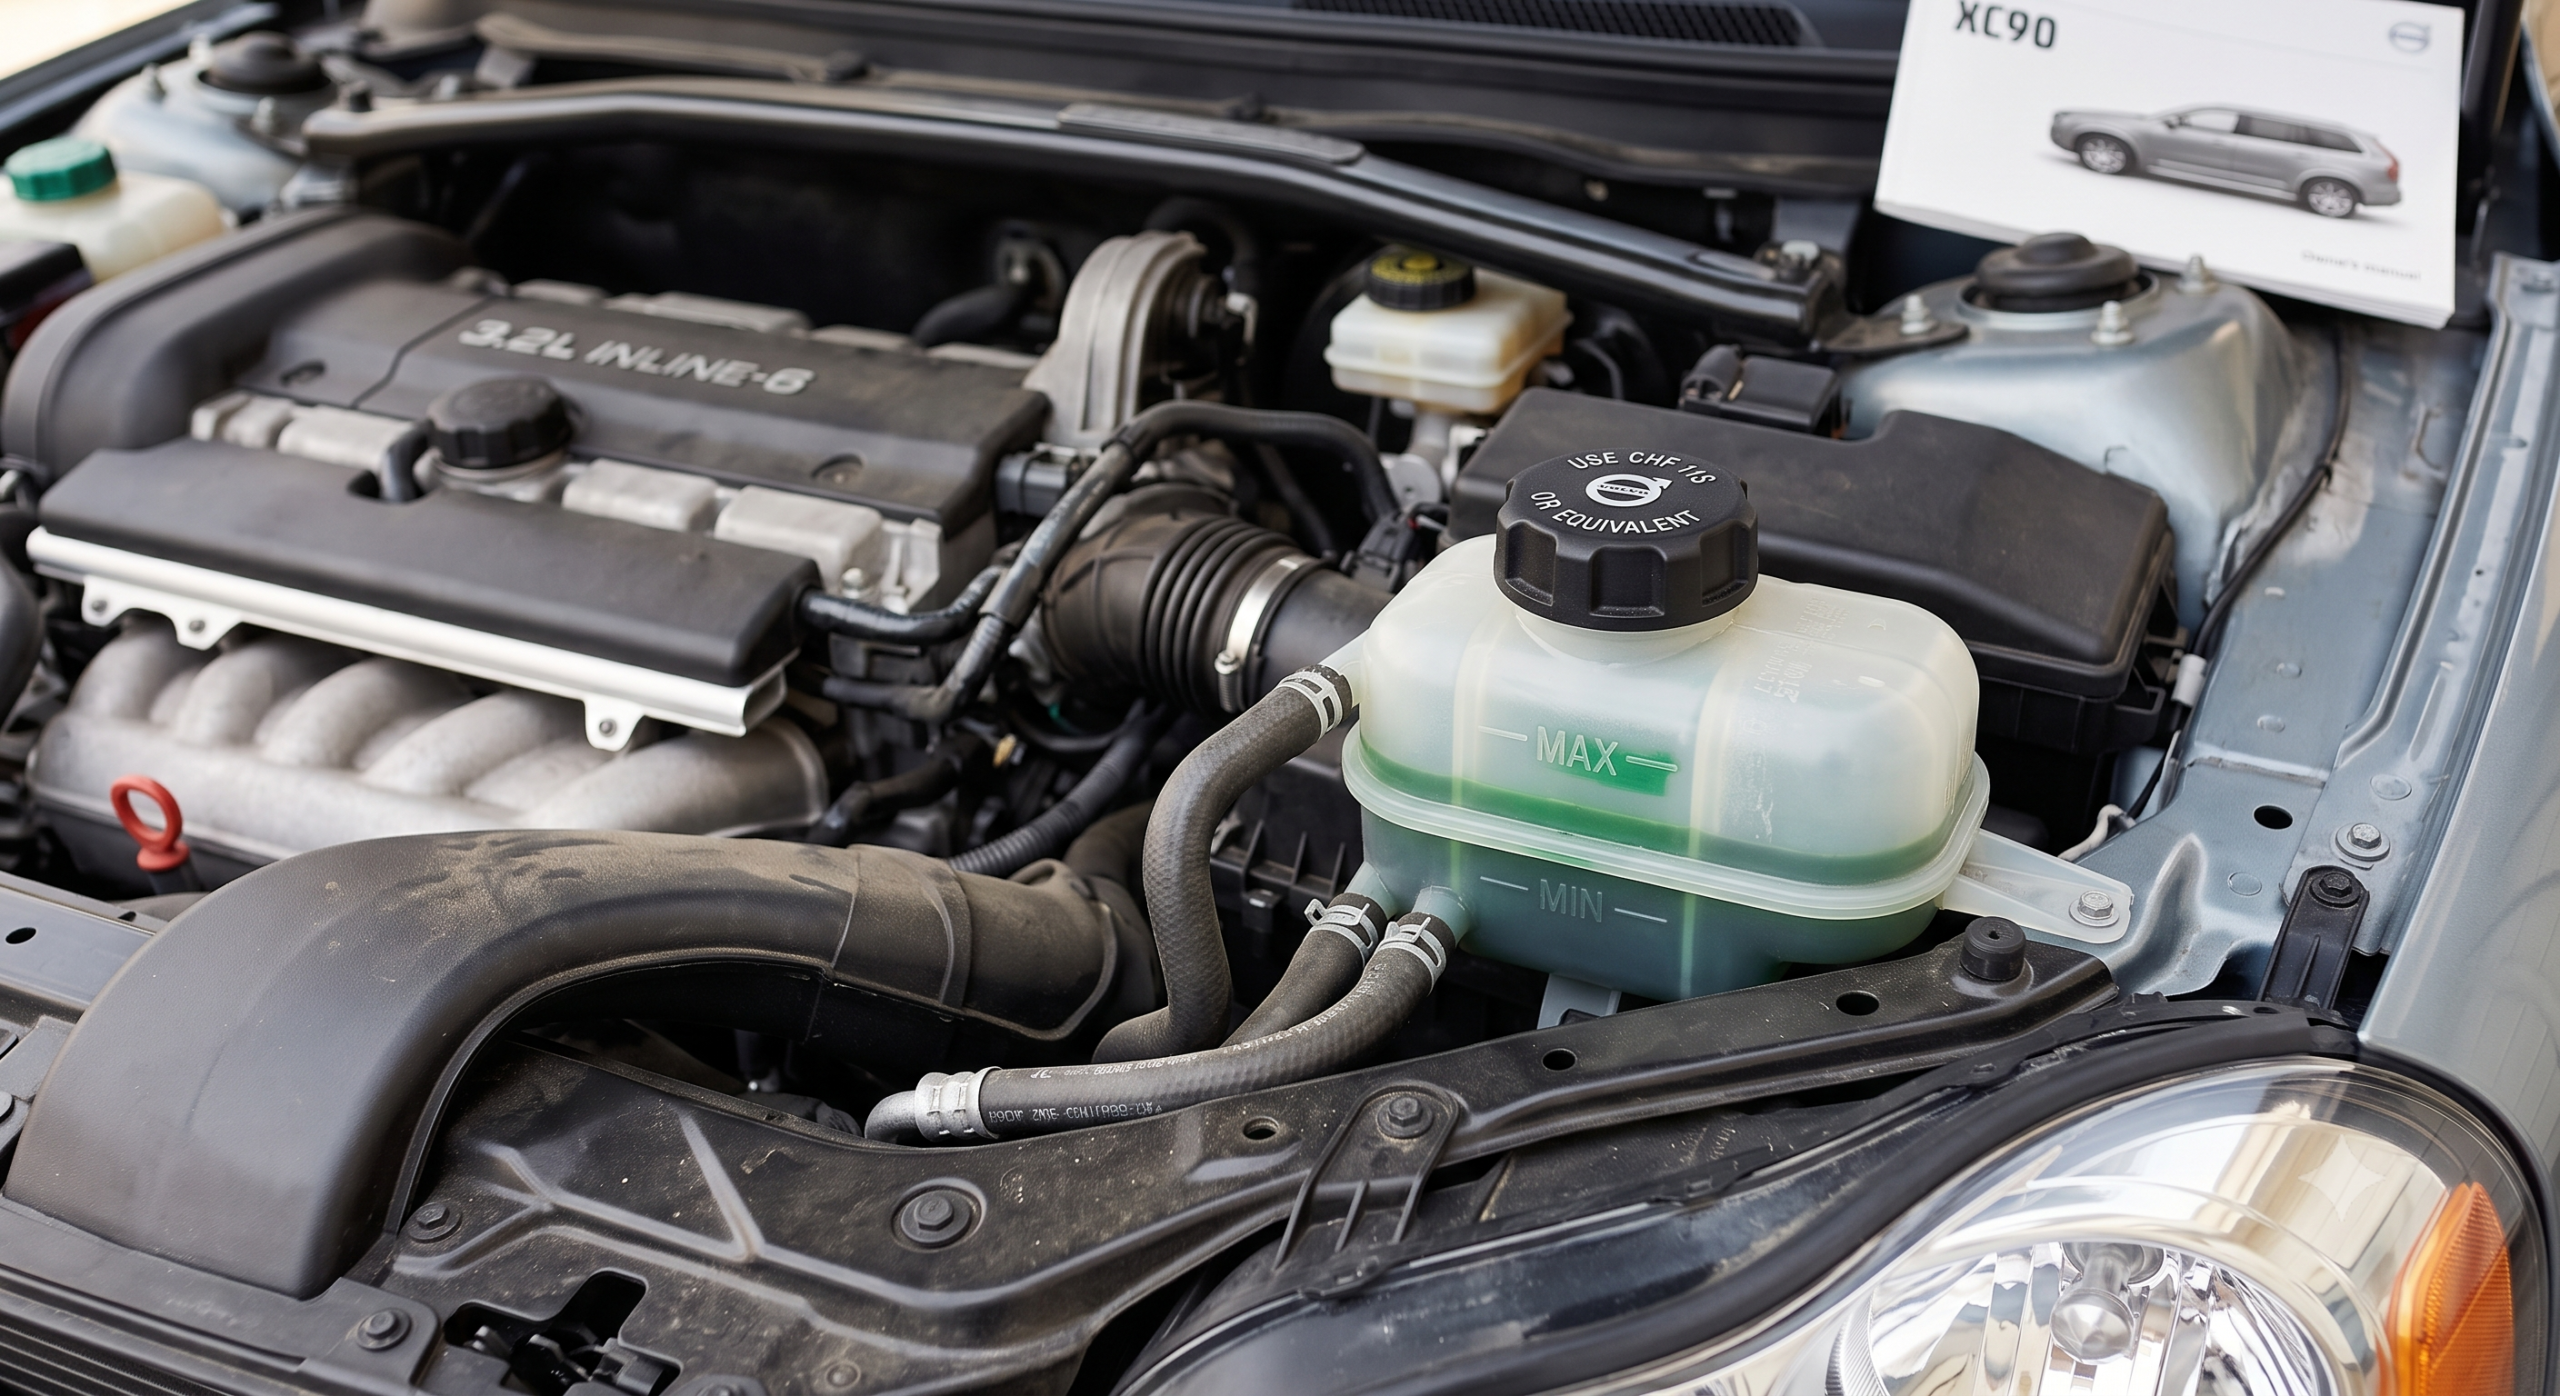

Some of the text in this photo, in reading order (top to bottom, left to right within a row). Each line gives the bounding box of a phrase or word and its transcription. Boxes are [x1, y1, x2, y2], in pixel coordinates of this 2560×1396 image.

[1956, 0, 2056, 48] XC90
[459, 319, 815, 395] 3.2L INLINE-6
[1567, 451, 1717, 484] USE CHF 11S
[1530, 491, 1700, 534] OR EQUIVALENT
[1537, 725, 1619, 776] MAX
[1539, 878, 1603, 923] MIN
